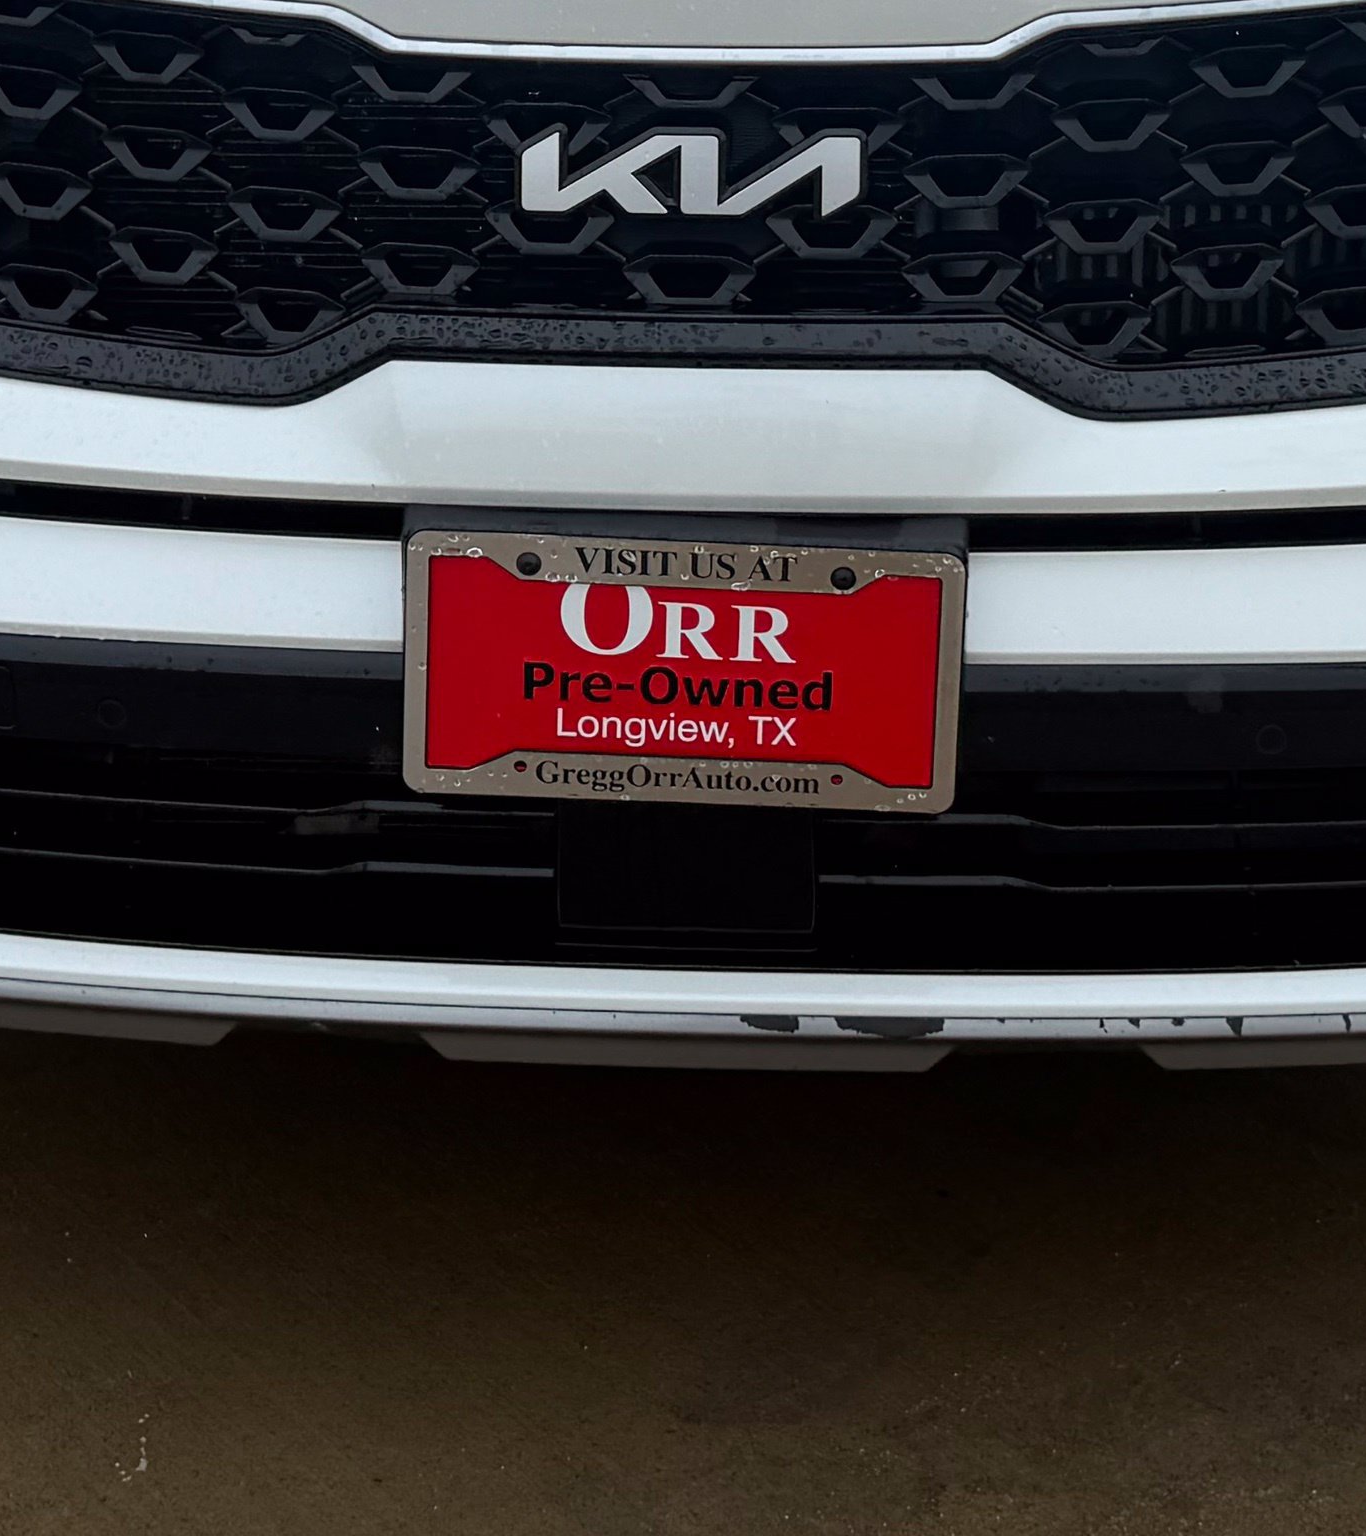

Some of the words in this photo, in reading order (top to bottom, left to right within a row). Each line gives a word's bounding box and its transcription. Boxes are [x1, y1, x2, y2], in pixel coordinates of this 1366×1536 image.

[521, 131, 861, 217] KIA
[575, 547, 677, 578] VISIT
[690, 550, 736, 581] US
[750, 556, 798, 583] AT
[560, 583, 796, 664] ORR
[522, 662, 832, 711] Pre-Owned
[556, 707, 735, 748] Longview,
[749, 715, 797, 747] TX
[535, 760, 820, 796] GreggOrrAuto.com
